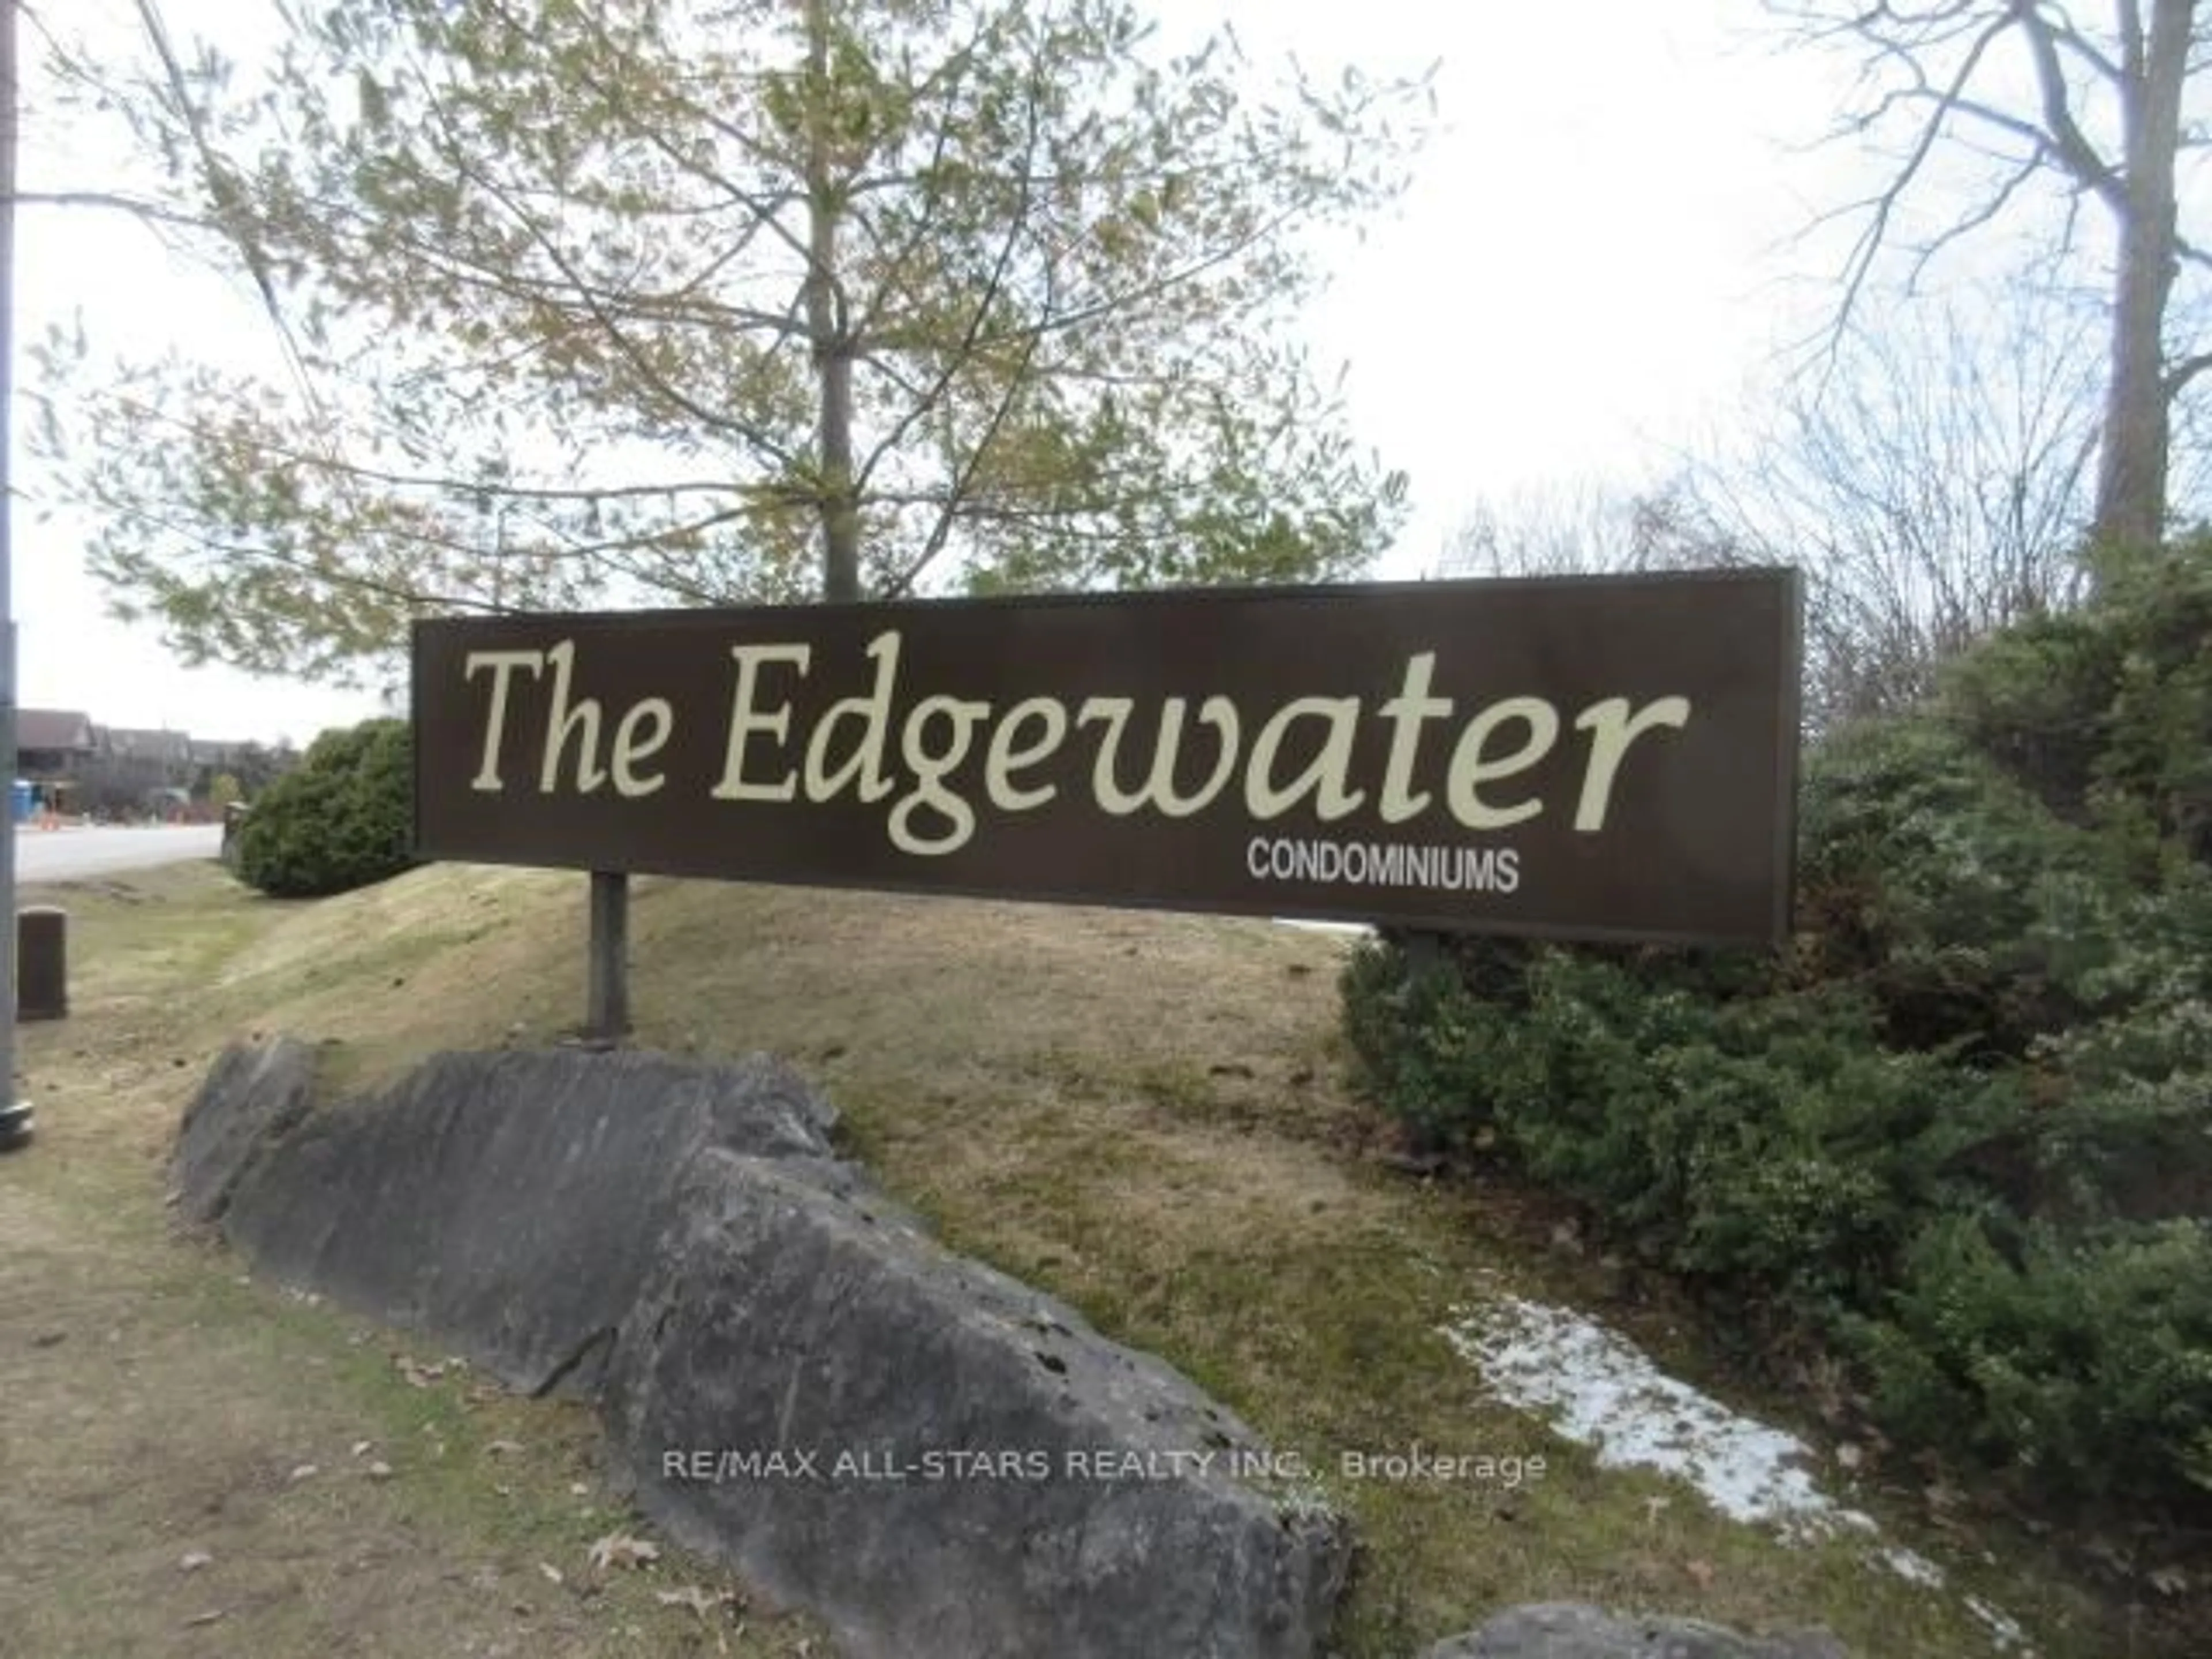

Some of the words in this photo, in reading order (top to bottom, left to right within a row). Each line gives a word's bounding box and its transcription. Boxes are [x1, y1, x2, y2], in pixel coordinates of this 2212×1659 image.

[465, 639, 673, 797] The
[712, 632, 1691, 856] Edgewater
[1247, 837, 1520, 895] CONDOMINIUMS
